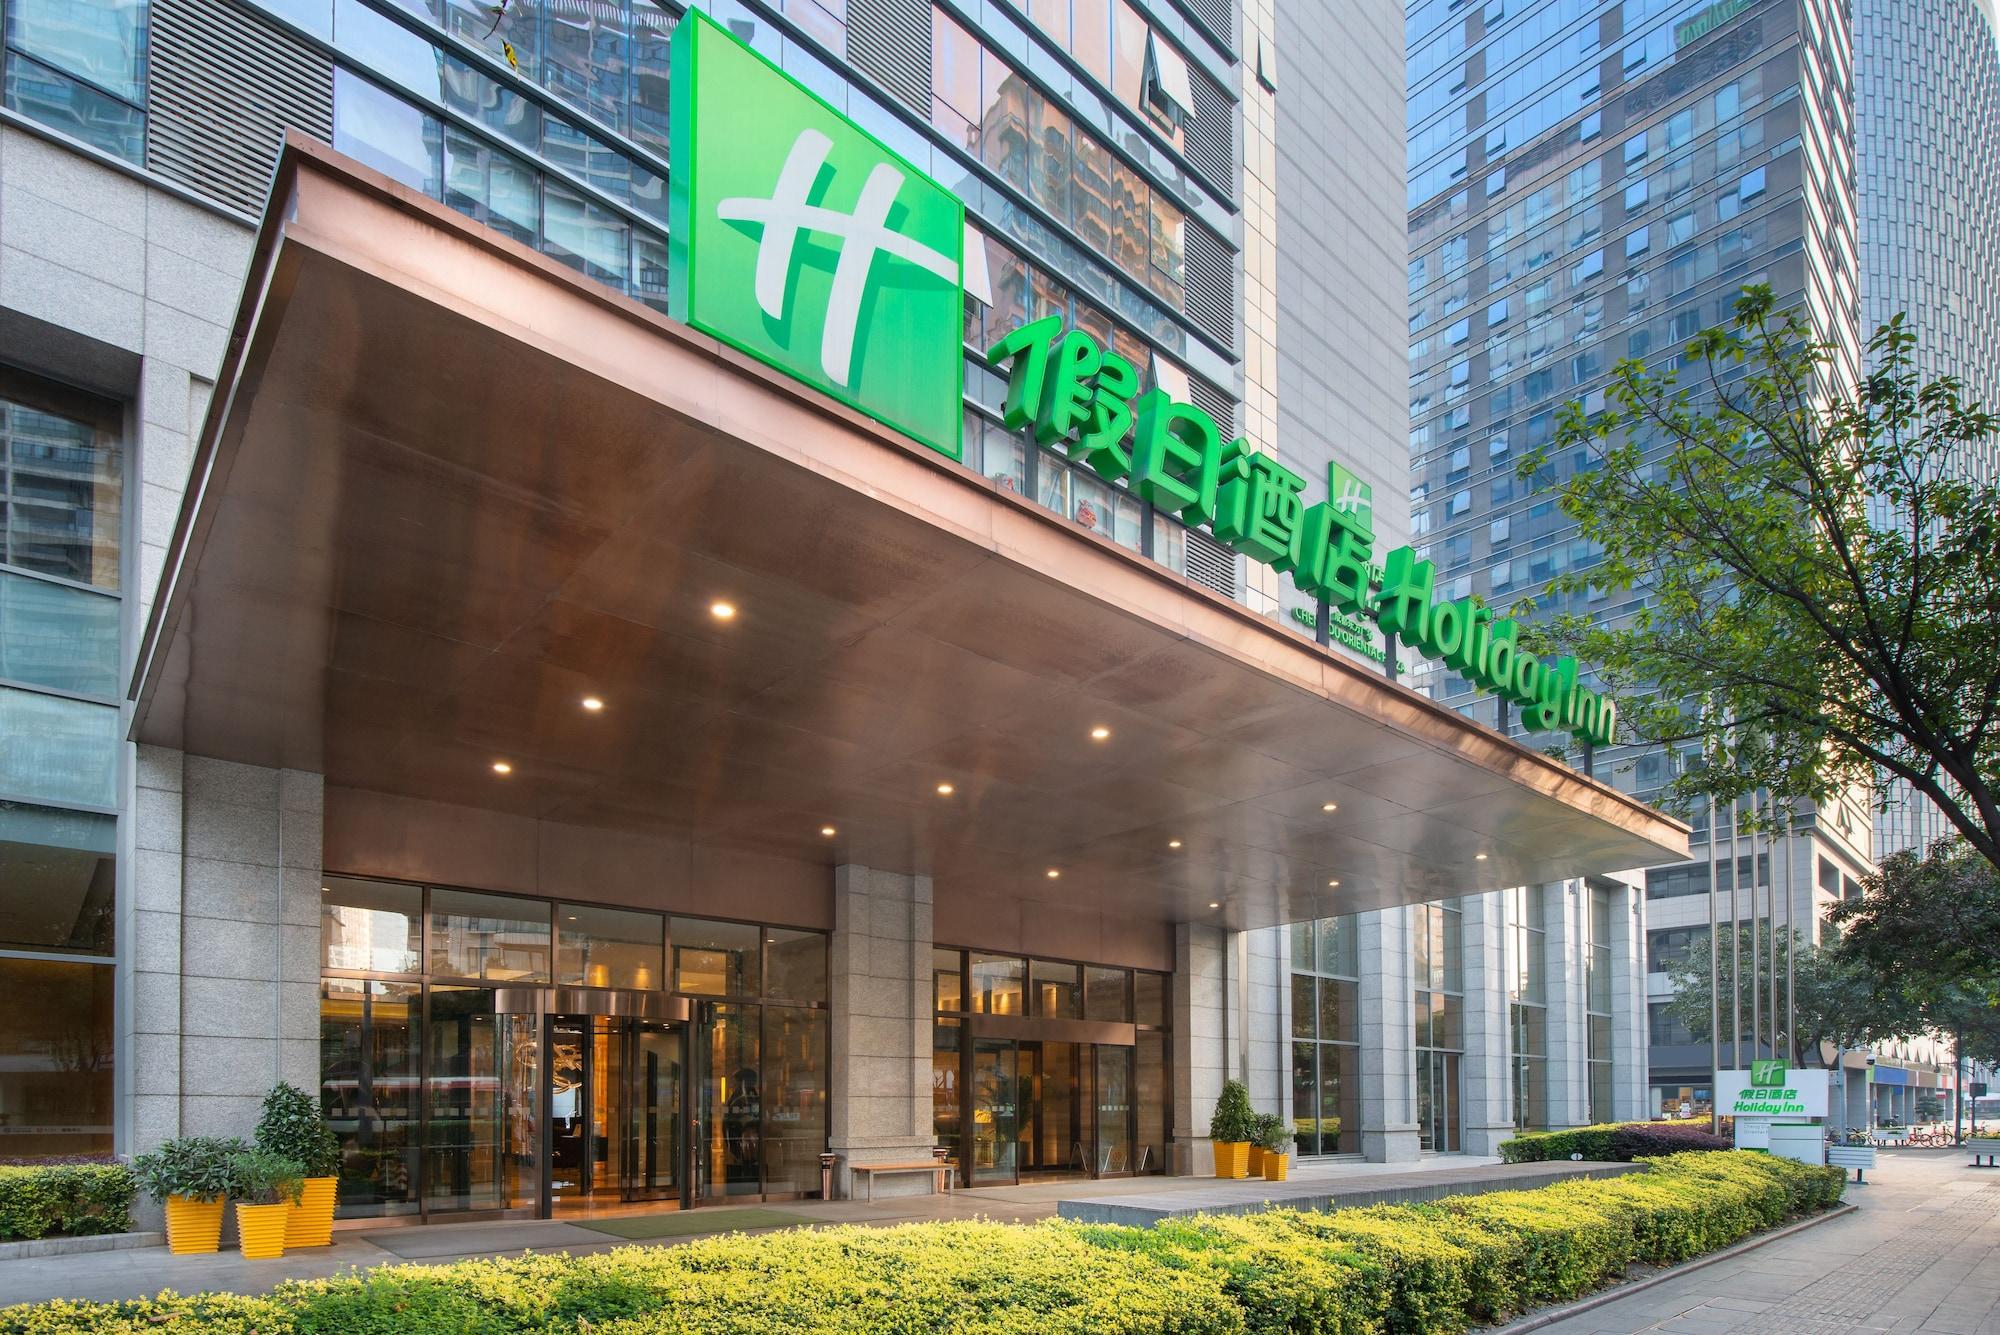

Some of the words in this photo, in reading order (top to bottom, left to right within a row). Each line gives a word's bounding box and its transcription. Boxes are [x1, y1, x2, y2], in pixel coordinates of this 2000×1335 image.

[987, 314, 1375, 613] 假日酒店
[1294, 606, 1341, 642] CHEDU
[1342, 631, 1383, 661] ORIENTAL
[1373, 545, 1562, 732] Holiday
[1557, 656, 1617, 747] Inn
[1733, 1101, 1781, 1115] Holiday
[1783, 1101, 1805, 1113] Inn
[1739, 1088, 1798, 1100] 假日酒店
